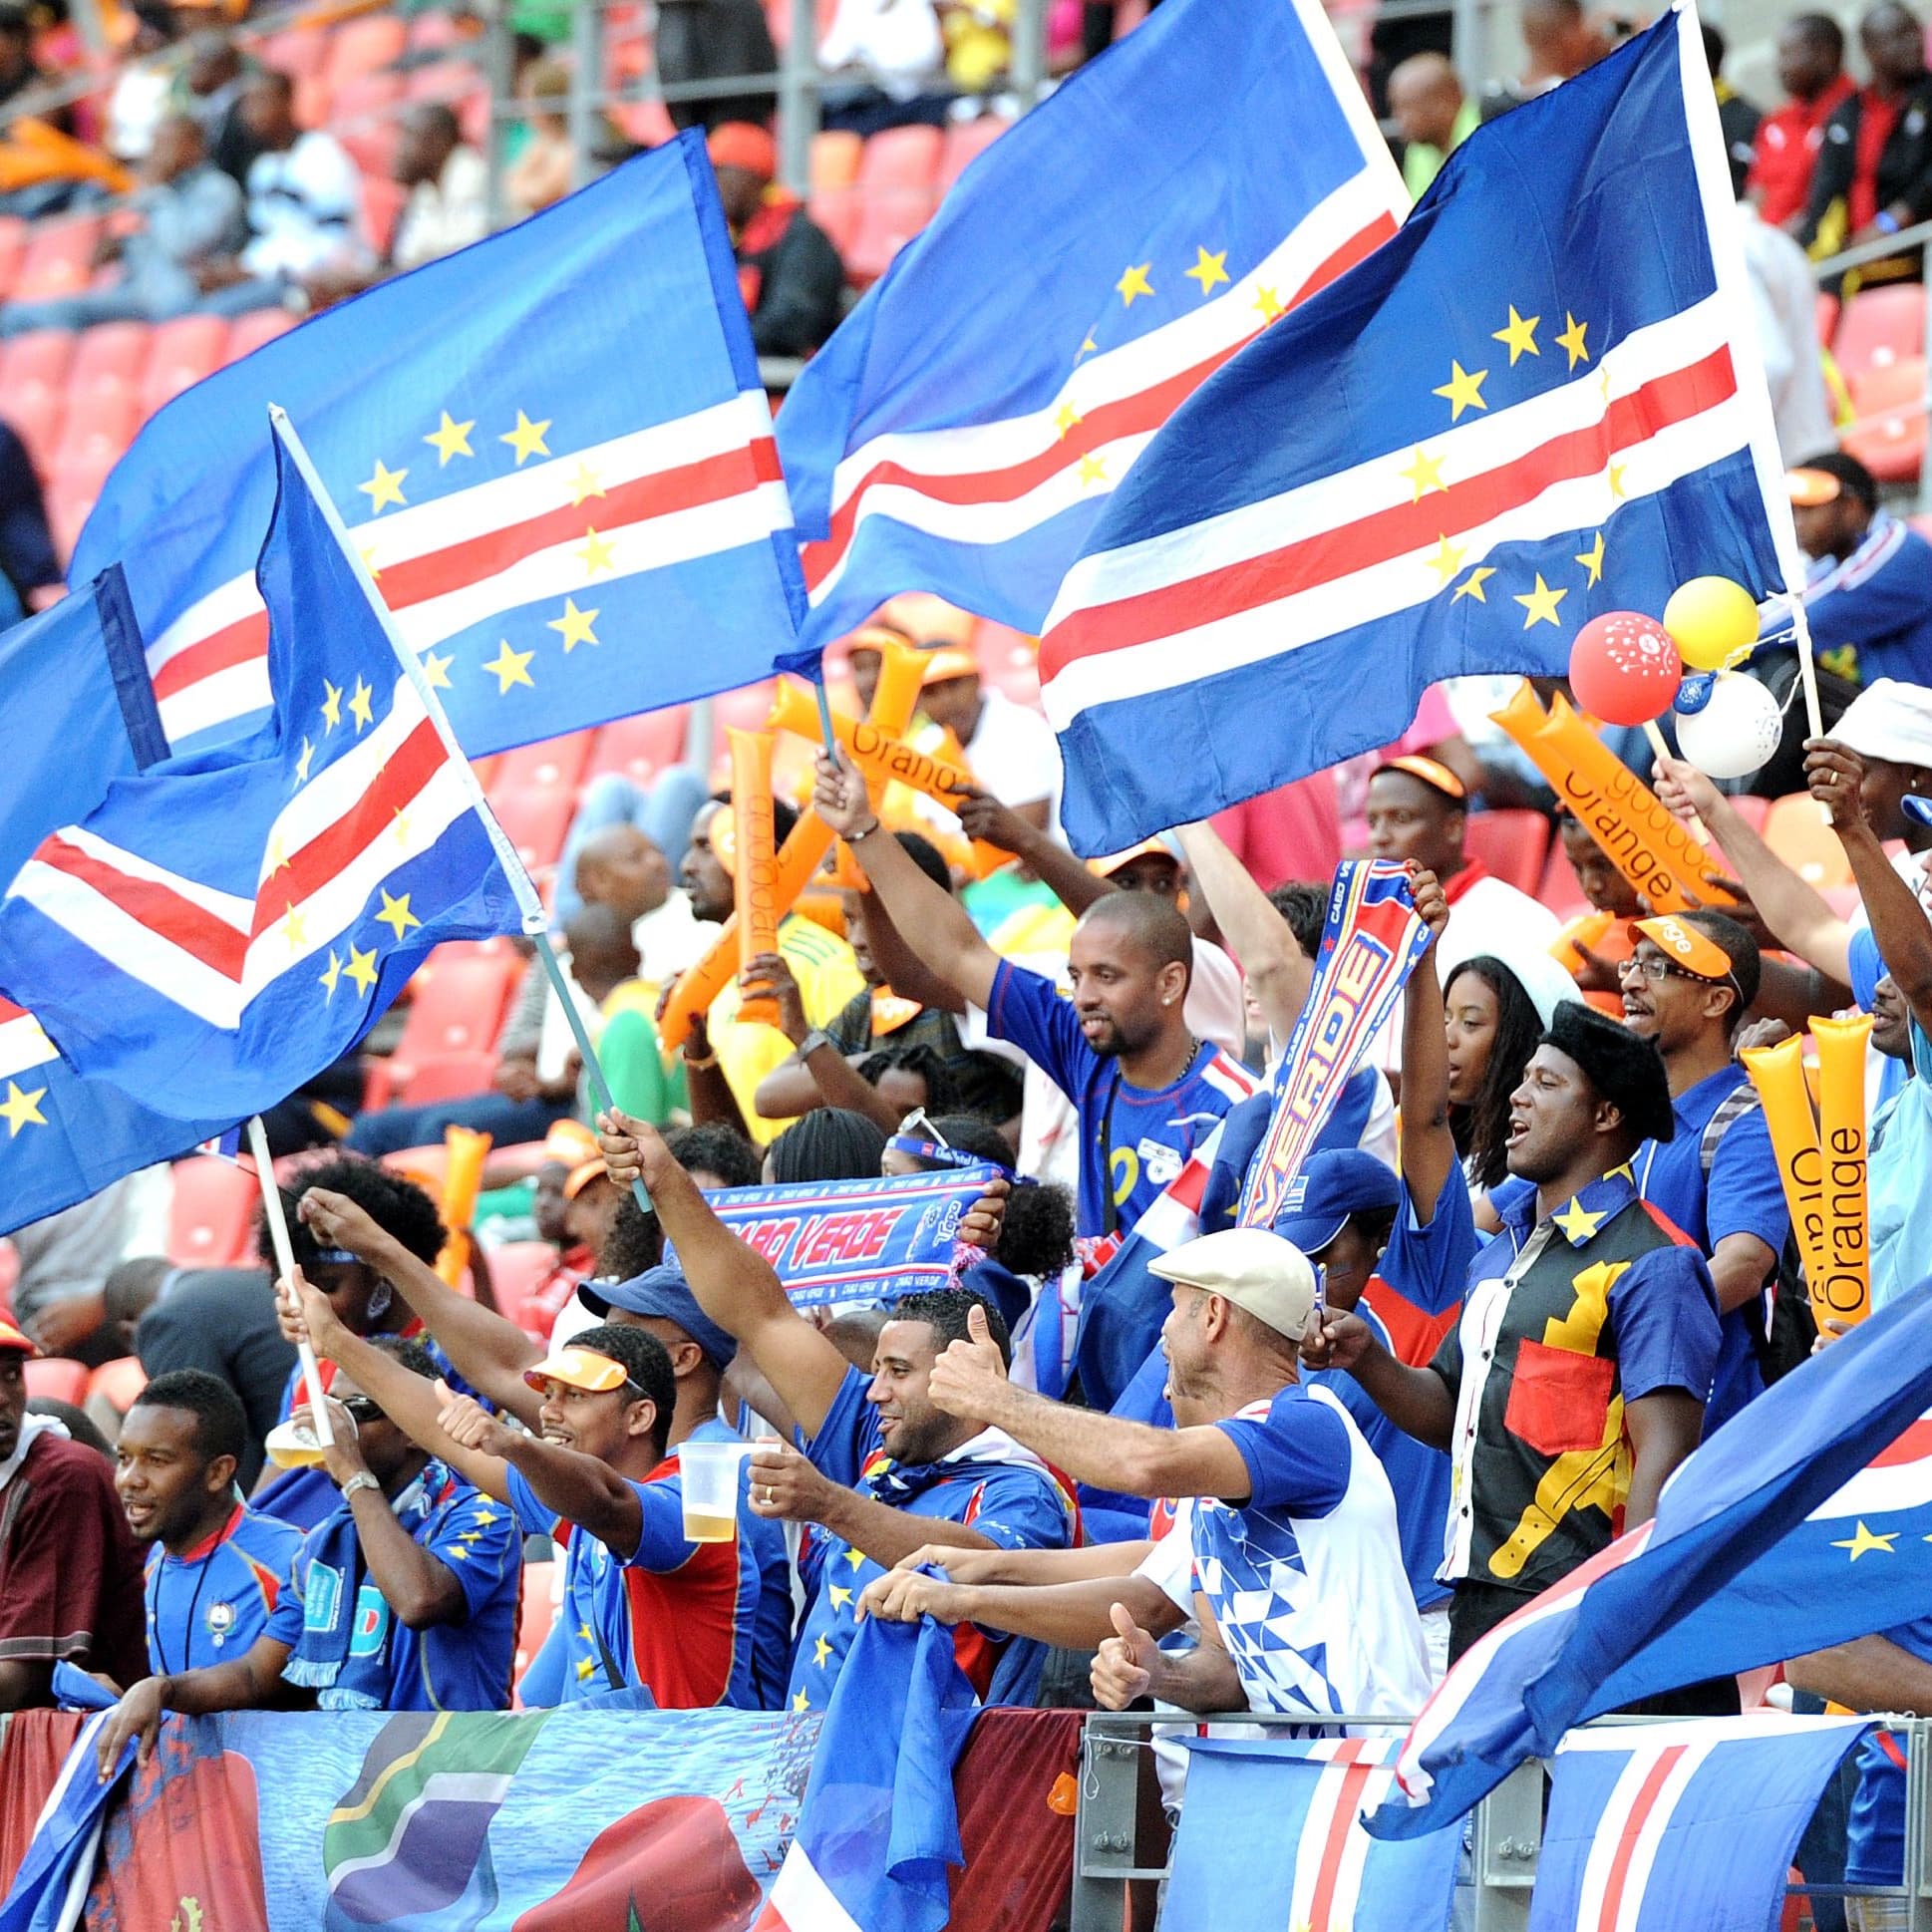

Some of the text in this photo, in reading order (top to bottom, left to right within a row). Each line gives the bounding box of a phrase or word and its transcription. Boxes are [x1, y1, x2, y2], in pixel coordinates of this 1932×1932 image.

[852, 721, 957, 795] Orang
[1250, 941, 1383, 1225] VERDE
[789, 1204, 913, 1271] VERDE
[1825, 1127, 1867, 1313] Orange
